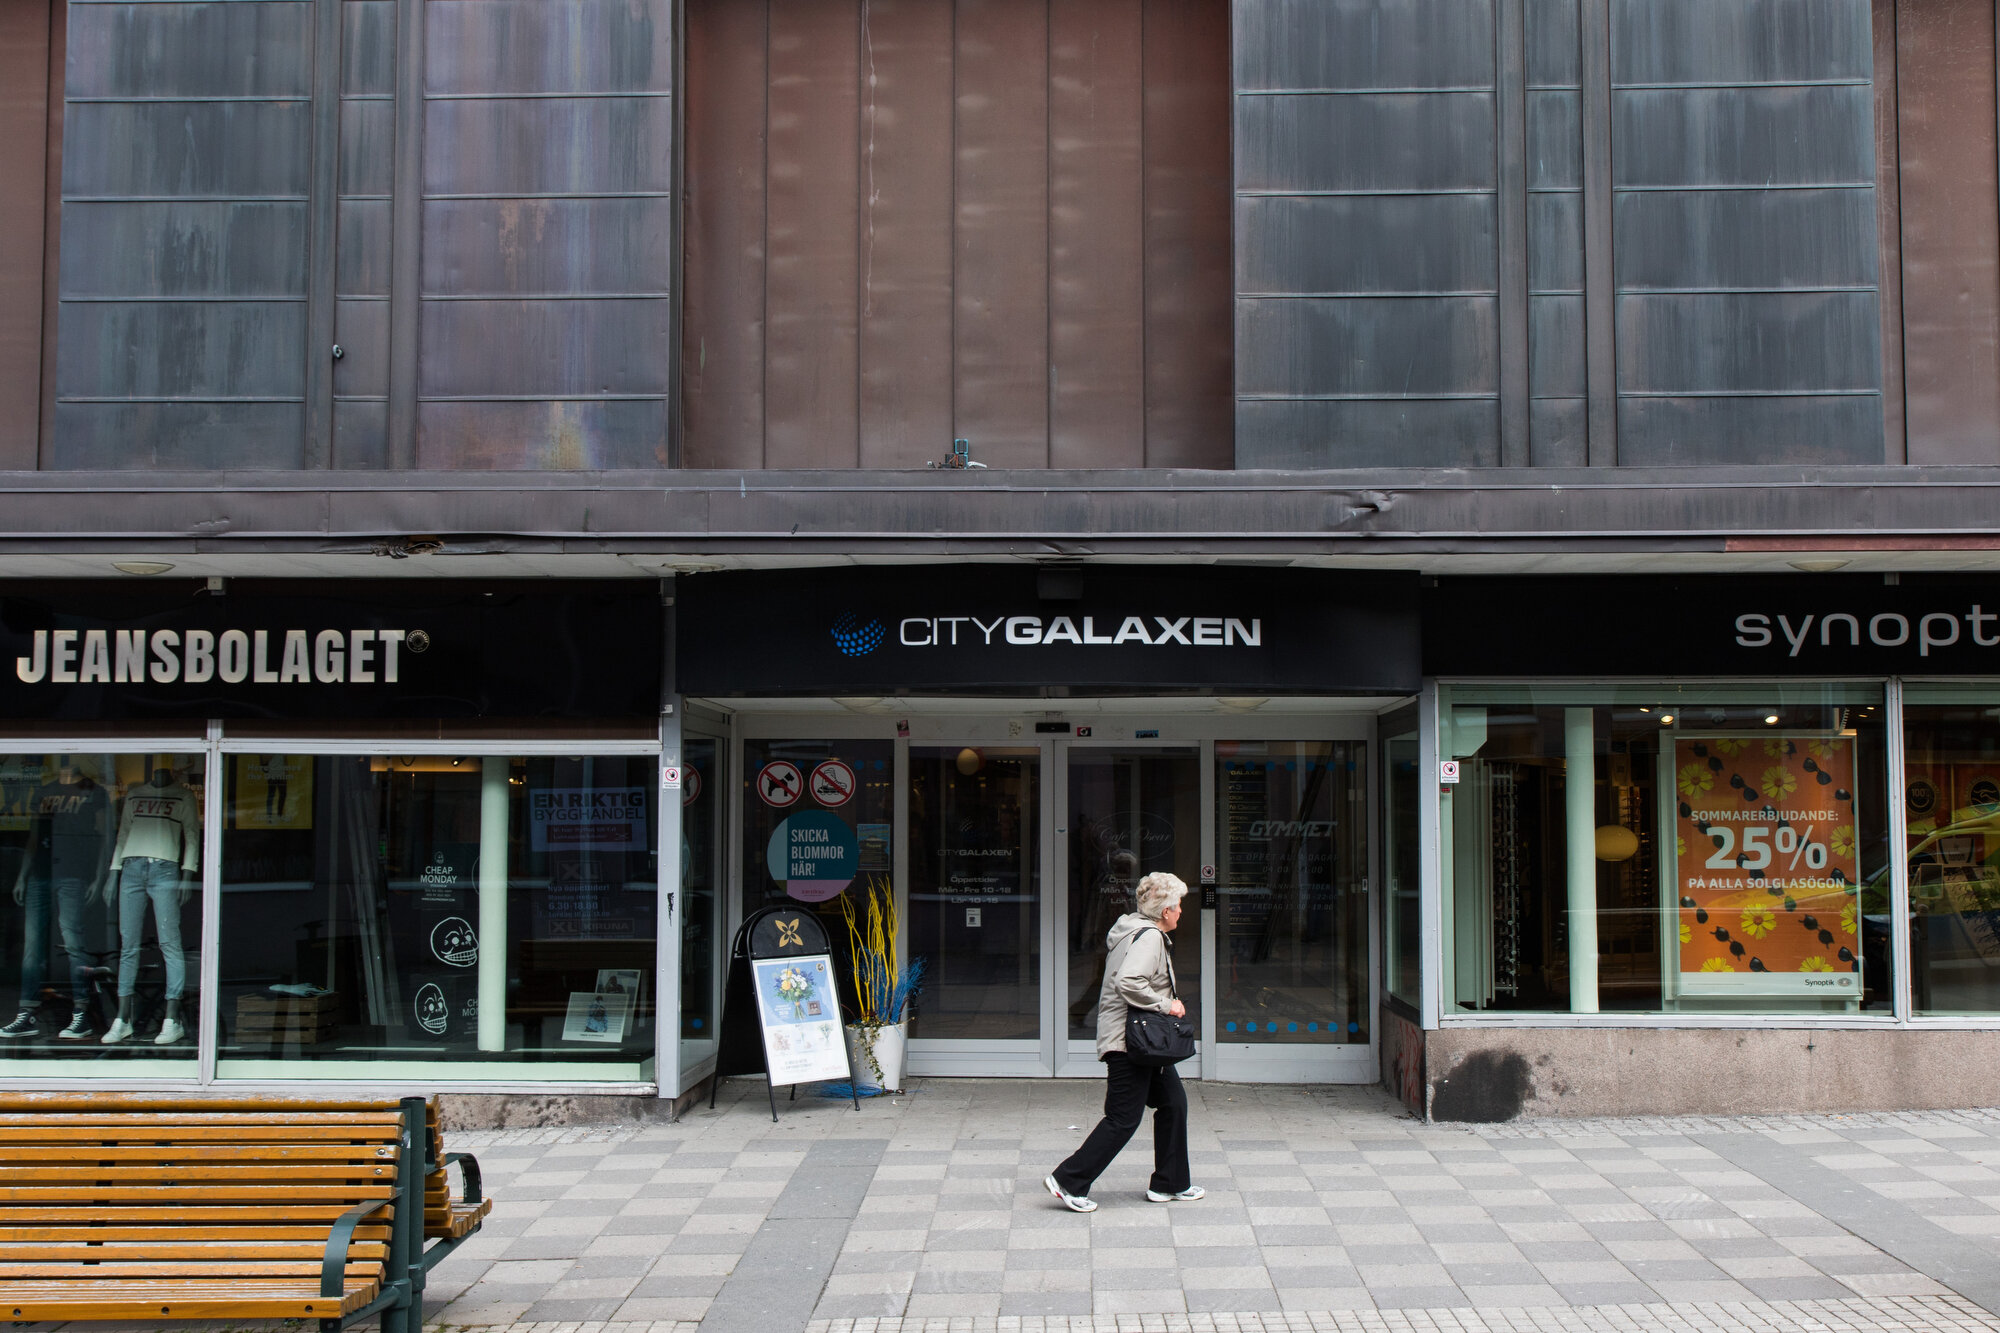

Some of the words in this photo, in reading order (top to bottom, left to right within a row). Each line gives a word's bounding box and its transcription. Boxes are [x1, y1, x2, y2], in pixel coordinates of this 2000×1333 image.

[899, 616, 1261, 647] CITYGALAXEN
[1734, 604, 2000, 657] synopt
[16, 629, 405, 683] JEANSBOLAGET
[534, 793, 564, 808] EN
[568, 792, 643, 808] RIKTIG
[535, 808, 645, 821] BYGGHANDEL
[1690, 810, 1839, 822] SOMMARERBJUDANDE:
[791, 829, 830, 843] SKICKA
[1249, 820, 1338, 838] GYMMET
[791, 846, 844, 860] BLOMMOR
[1705, 824, 1828, 871] 25%
[425, 866, 454, 875] CHEAP
[791, 862, 816, 877] HÄR!
[420, 875, 458, 884] MONDAY
[1688, 875, 1706, 889] PÅ
[1708, 878, 1744, 889] ALLA
[1747, 875, 1845, 889] SOLGLASÖGON
[1804, 978, 1835, 987] Synoptik
